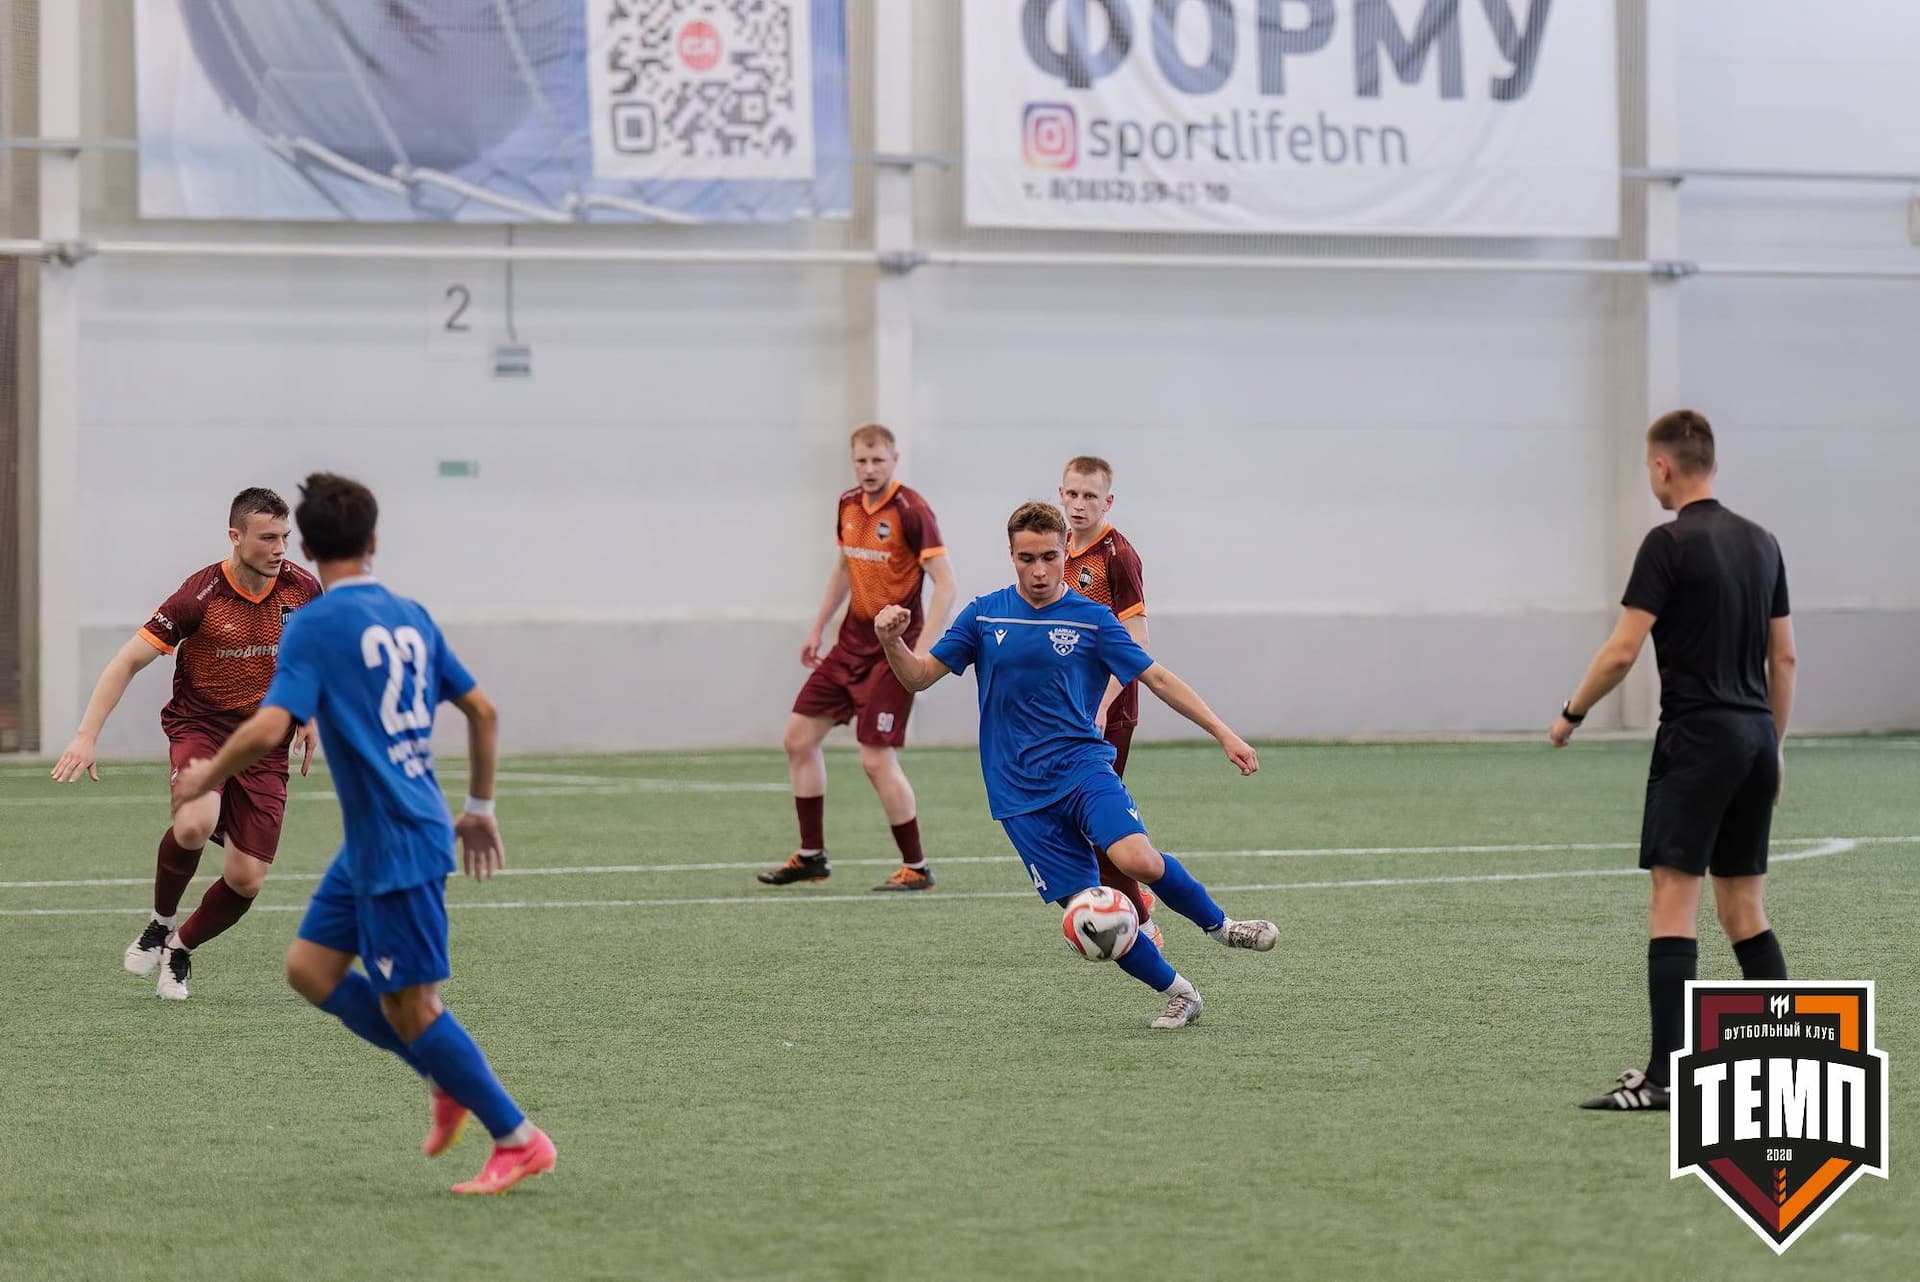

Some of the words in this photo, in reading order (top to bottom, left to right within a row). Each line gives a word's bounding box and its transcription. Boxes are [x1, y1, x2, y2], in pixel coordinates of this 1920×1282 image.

[1021, 0, 1552, 102] ФОРМУ
[1088, 111, 1409, 170] sportlifebrn
[444, 283, 471, 333] 2
[361, 624, 431, 736] 22
[1030, 863, 1048, 891] 4
